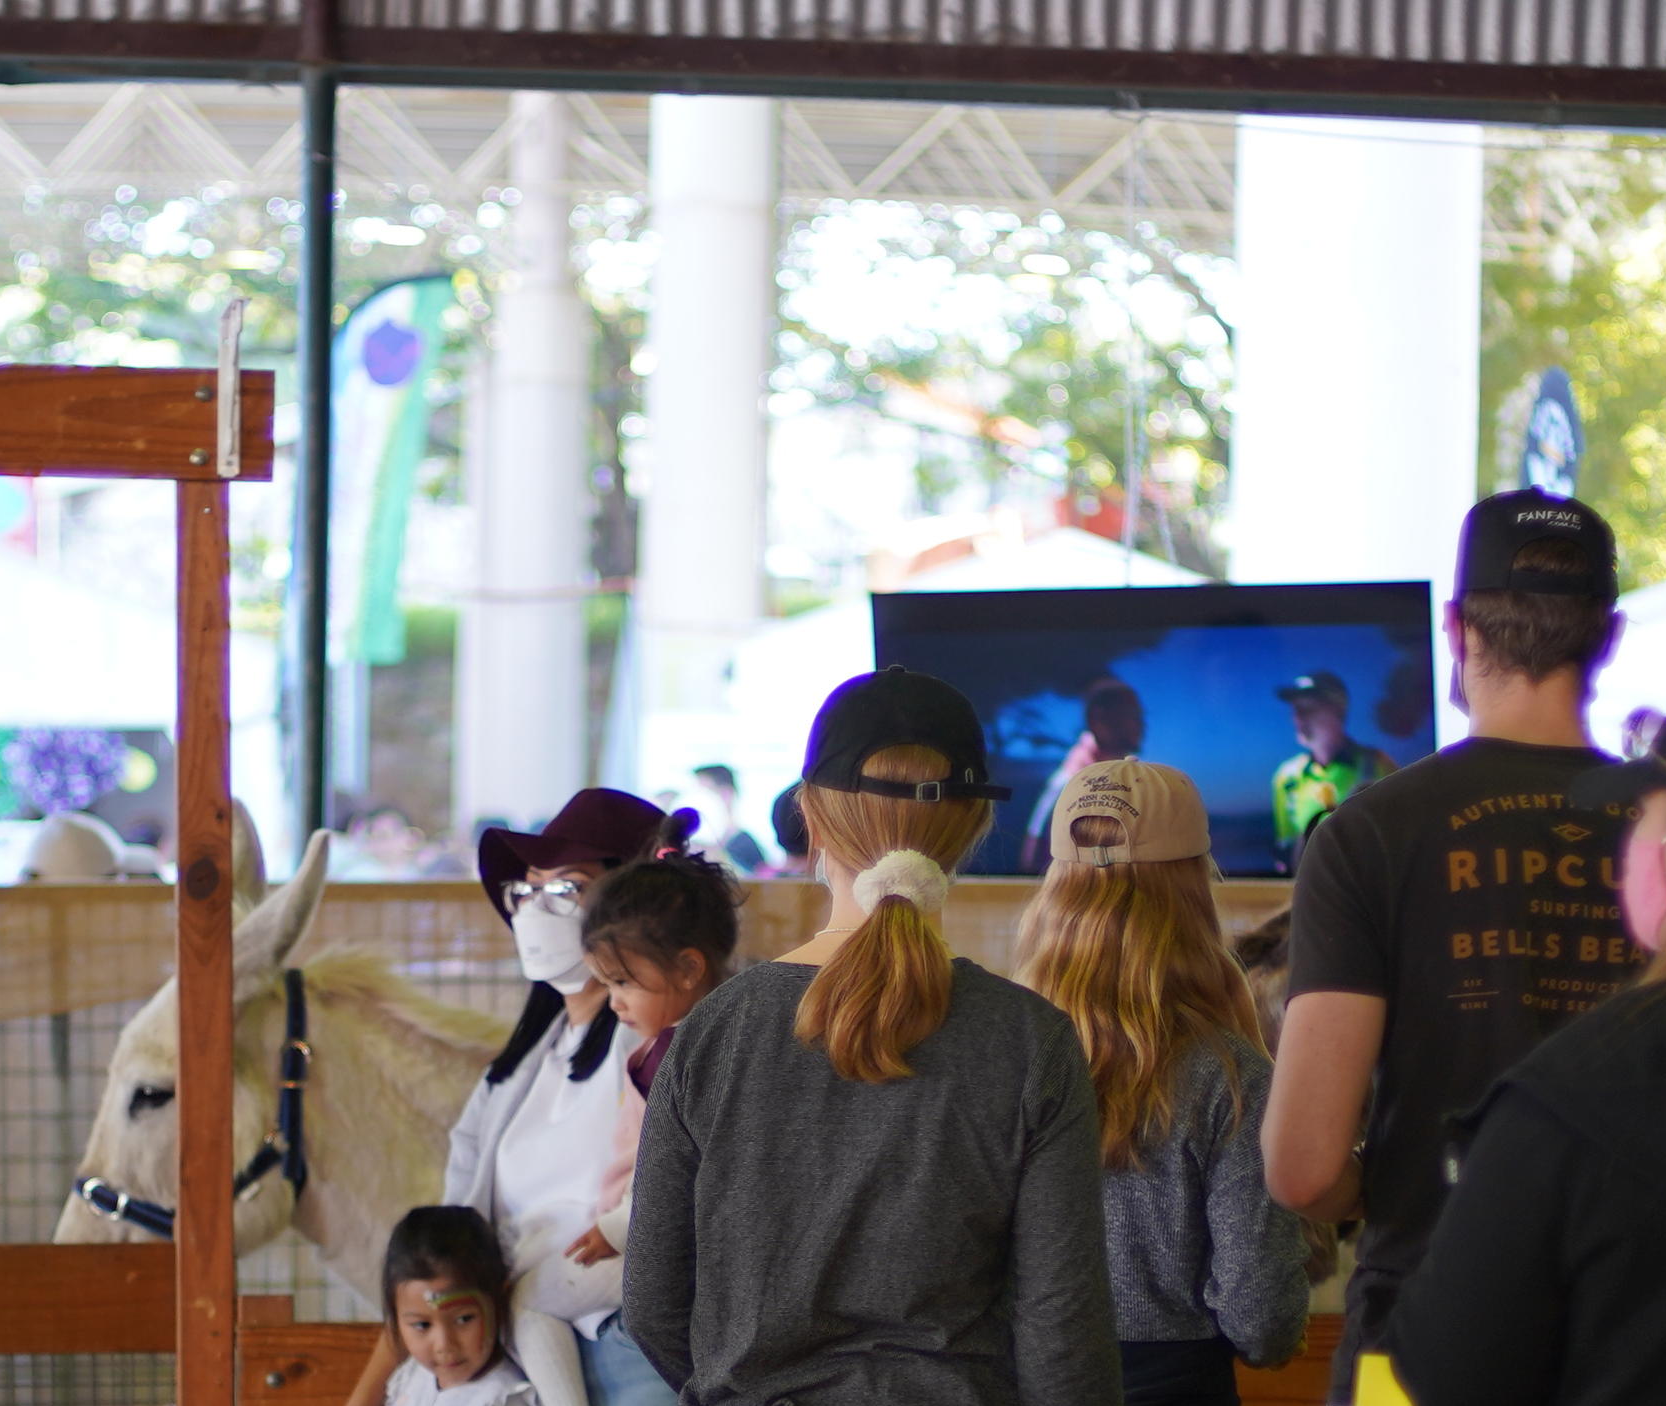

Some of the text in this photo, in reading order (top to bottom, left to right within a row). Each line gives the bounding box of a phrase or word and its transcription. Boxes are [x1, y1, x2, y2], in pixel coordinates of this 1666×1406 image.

[1517, 510, 1581, 524] FANFAVE
[1530, 900, 1622, 920] SURFING
[1452, 929, 1562, 959] BELLS
